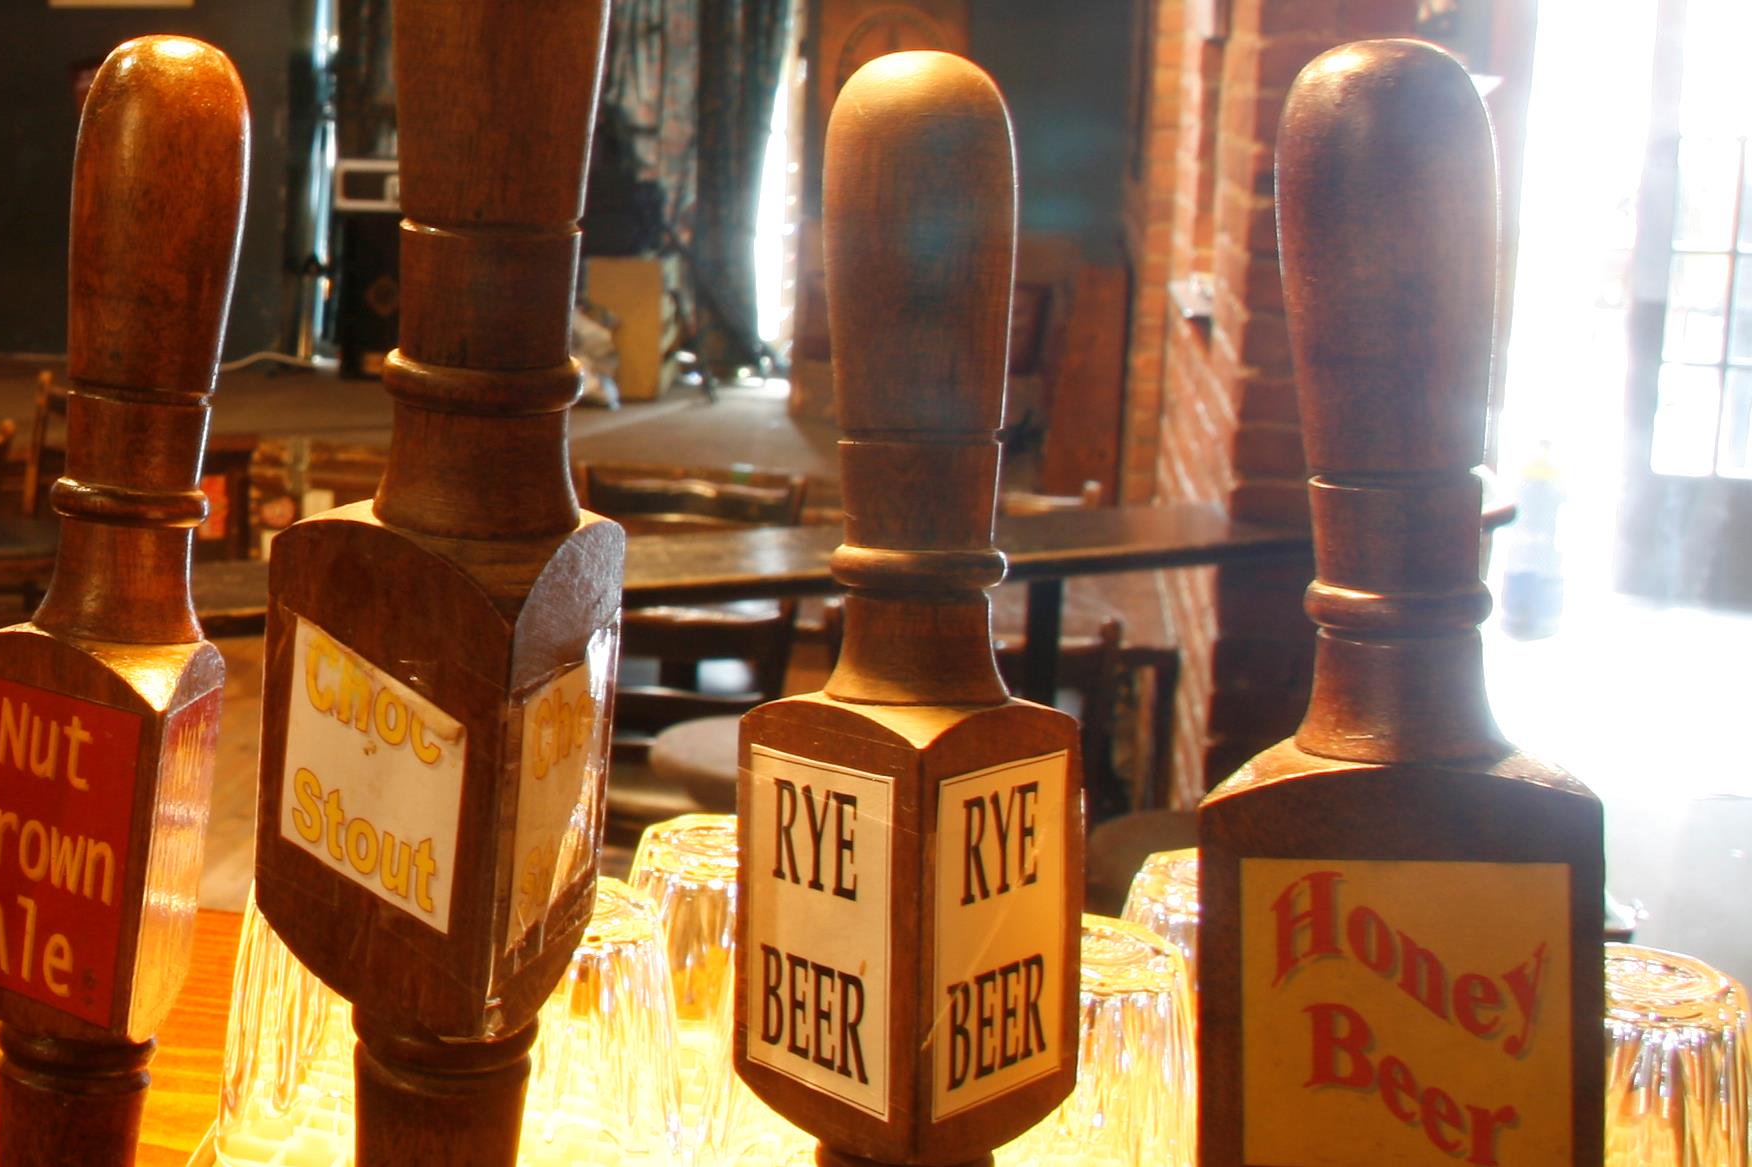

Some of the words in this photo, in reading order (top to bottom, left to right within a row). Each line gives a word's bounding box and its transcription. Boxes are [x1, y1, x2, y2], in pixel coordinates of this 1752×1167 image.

[291, 766, 436, 914] Stout
[772, 776, 858, 902] RYE
[960, 780, 1039, 907] RYE
[760, 942, 869, 1086] BEER
[947, 953, 1047, 1093] BEER
[1270, 870, 1548, 1058] Honey
[1301, 1002, 1522, 1167] Beer
